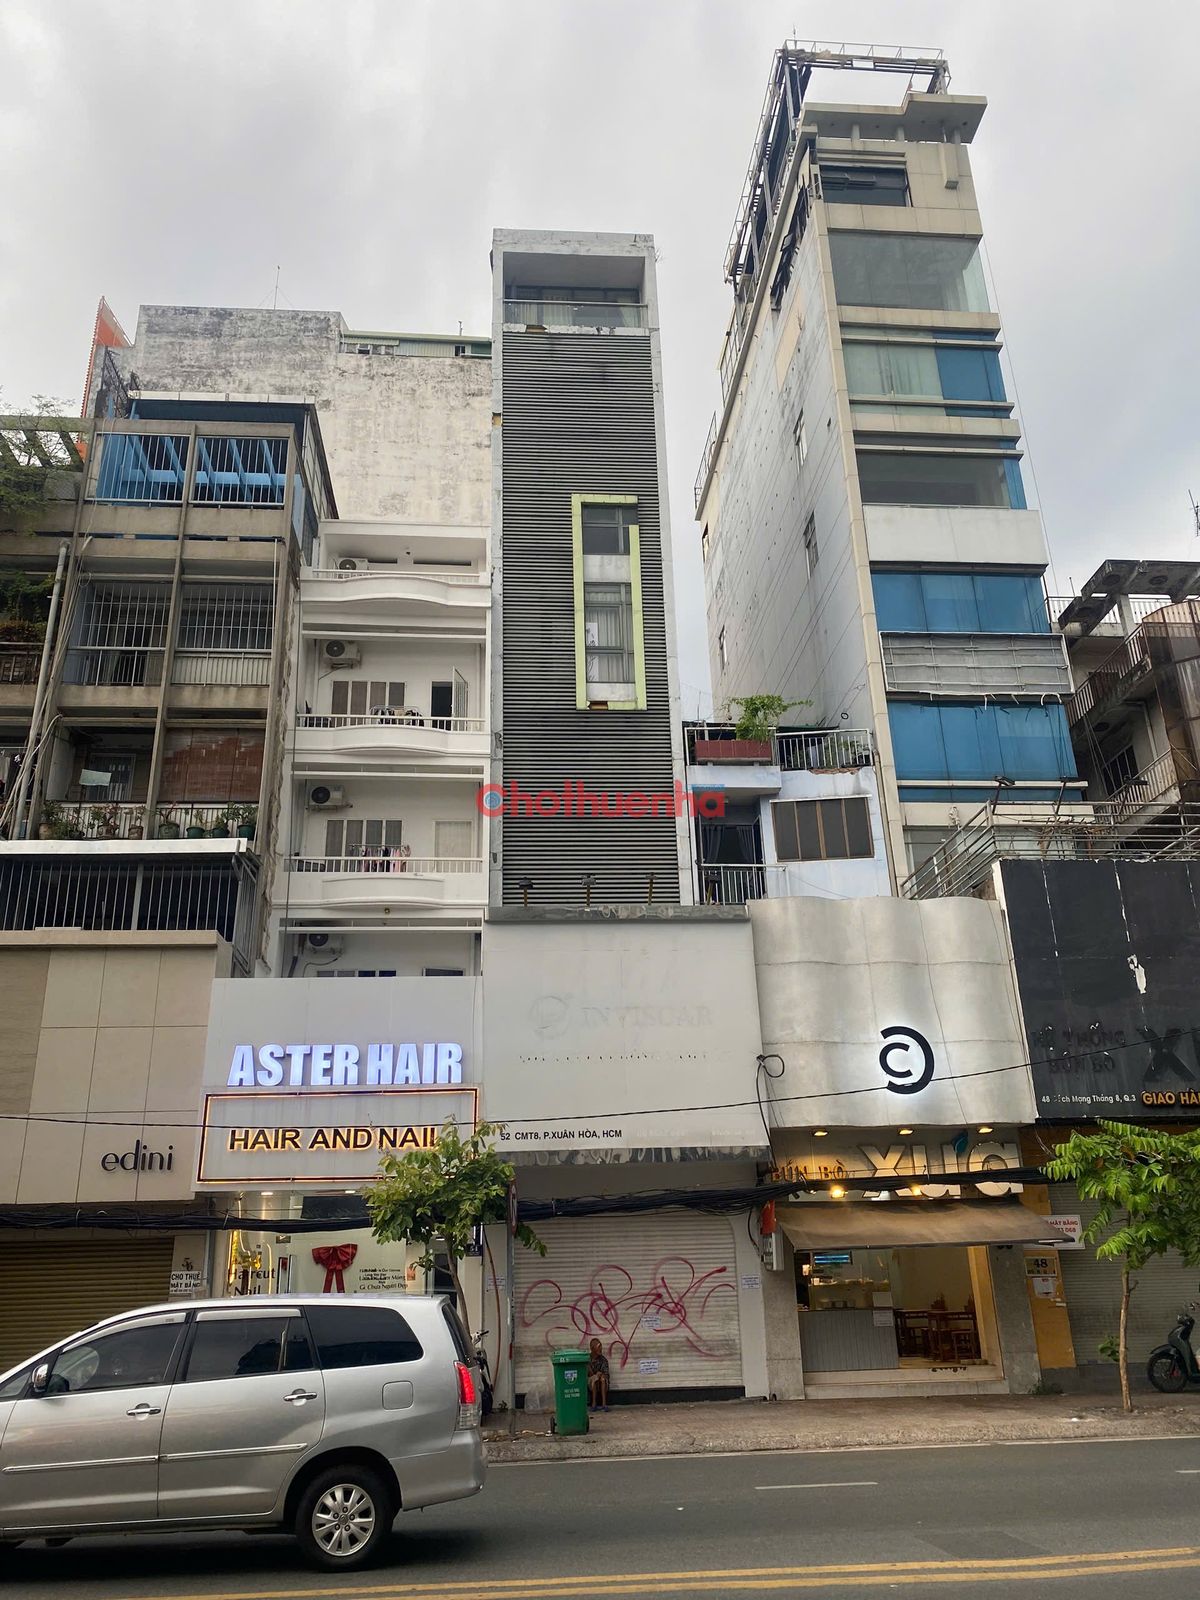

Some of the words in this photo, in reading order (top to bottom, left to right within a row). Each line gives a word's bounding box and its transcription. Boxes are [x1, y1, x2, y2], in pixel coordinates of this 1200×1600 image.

[227, 1044, 360, 1087] ASTER
[366, 1043, 463, 1085] HAIR
[1092, 1093, 1114, 1104] Tháng
[1142, 1092, 1176, 1105] GIAO
[229, 1128, 302, 1150] HAIR
[308, 1128, 379, 1149] AND
[500, 1132, 511, 1141] 52
[514, 1131, 541, 1141] CMT8,
[543, 1129, 575, 1140] P.XUÂN
[578, 1128, 600, 1139] HÒA,
[602, 1129, 622, 1138] HCM
[101, 1139, 173, 1171] edini
[1034, 1258, 1048, 1268] 48
